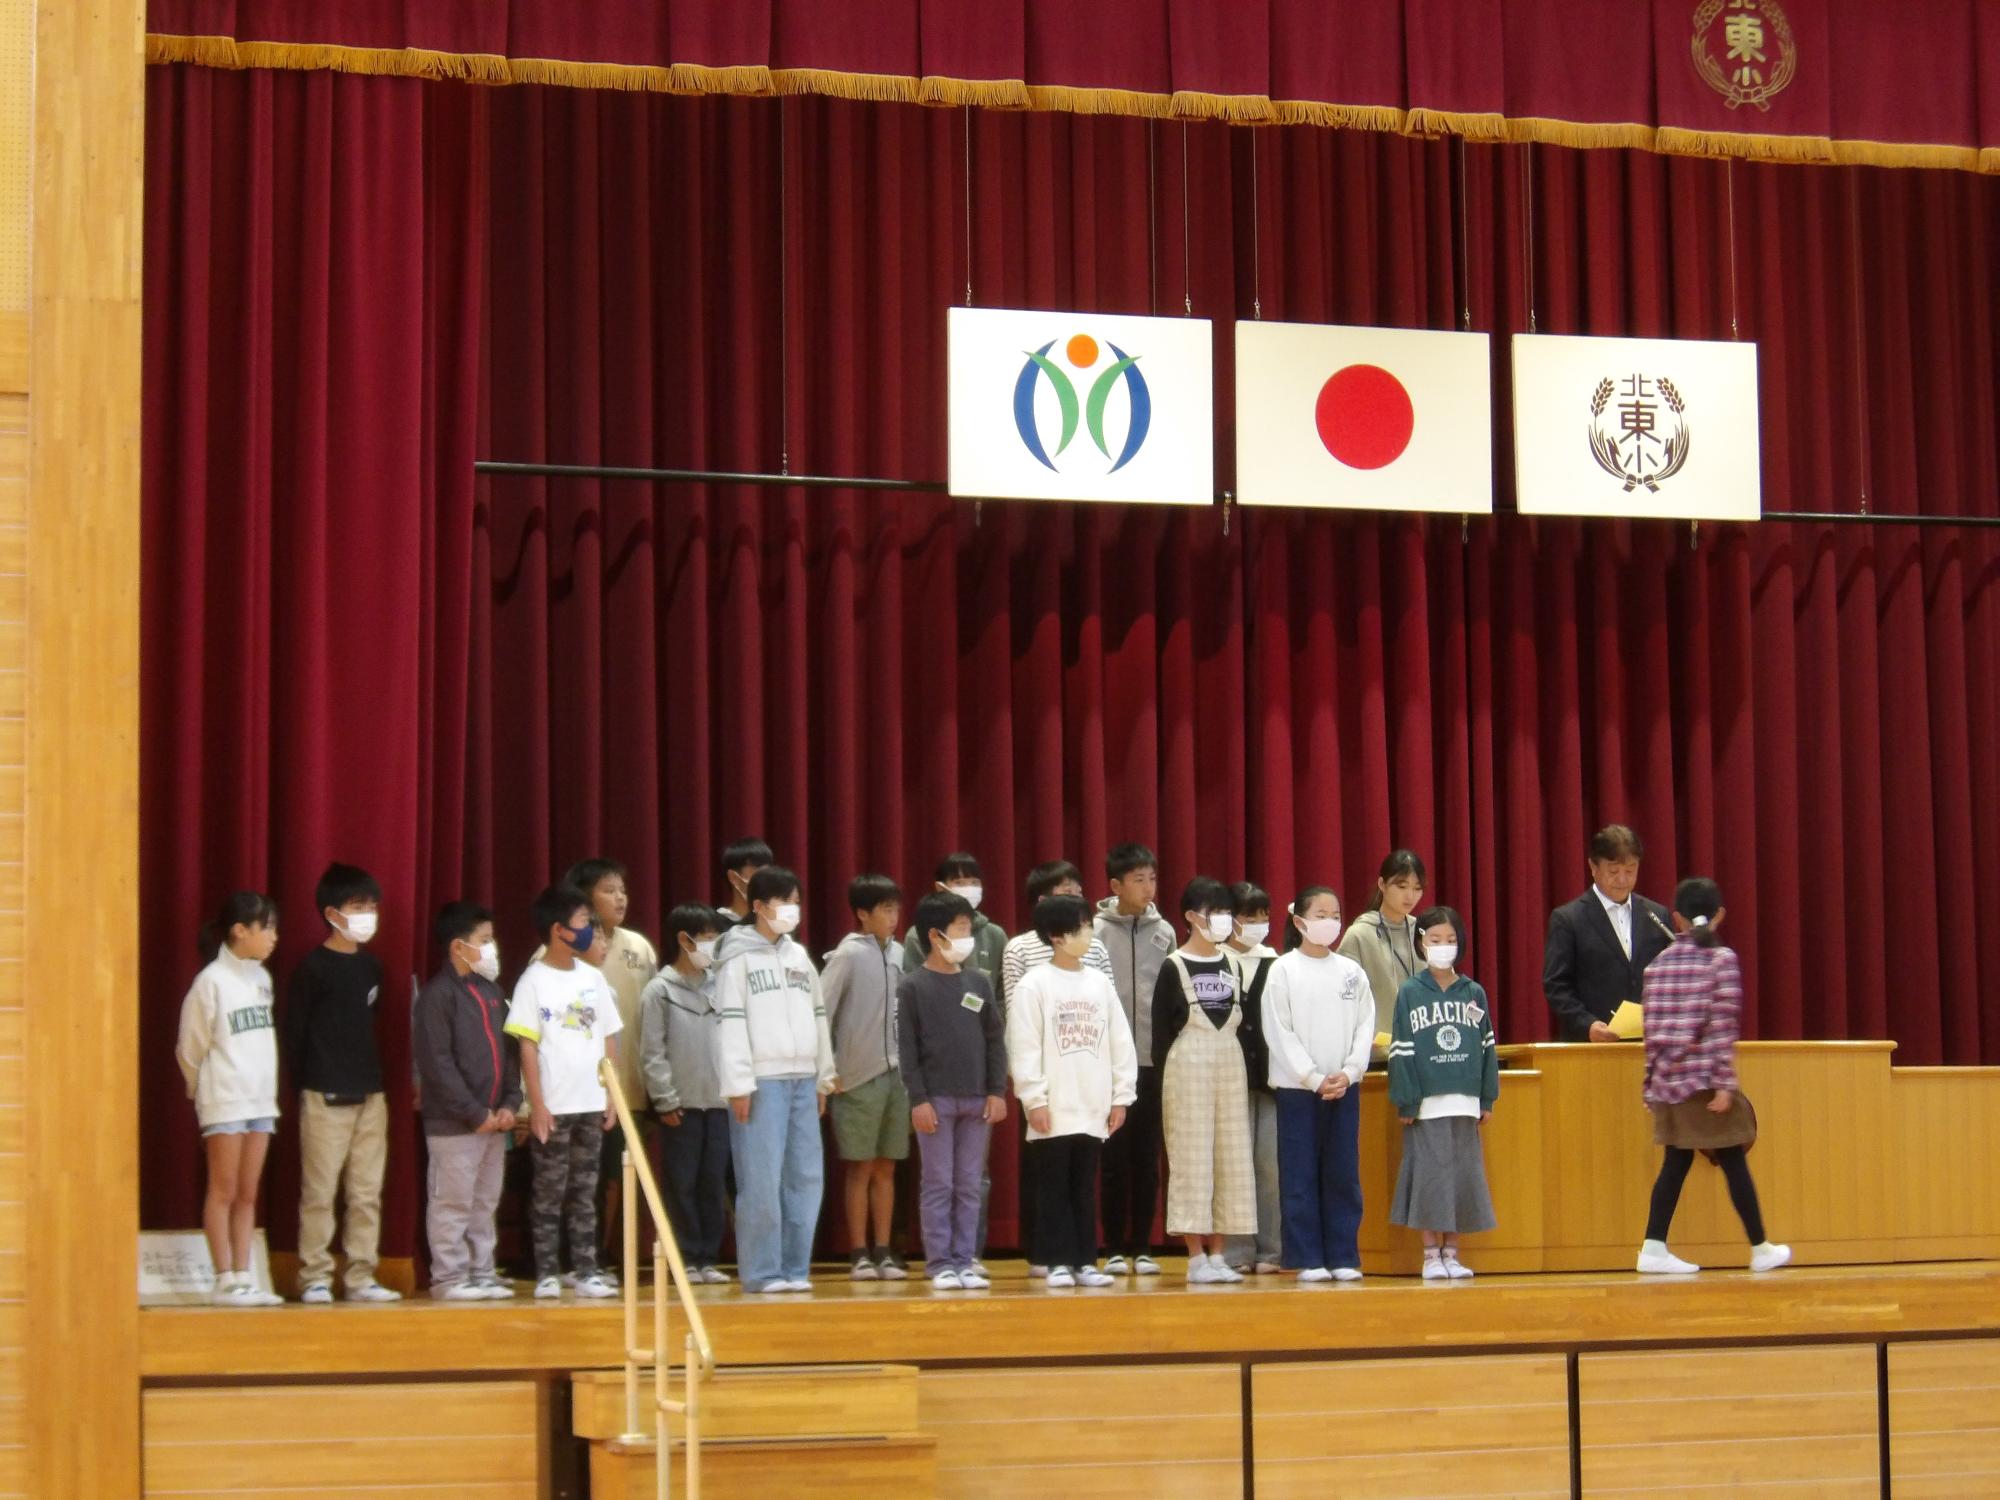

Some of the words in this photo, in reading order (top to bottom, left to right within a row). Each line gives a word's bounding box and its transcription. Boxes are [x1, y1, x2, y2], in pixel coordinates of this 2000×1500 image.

[1617, 373, 1662, 473] 北東小
[747, 968, 781, 995] BILL
[1193, 981, 1226, 993] STICKY
